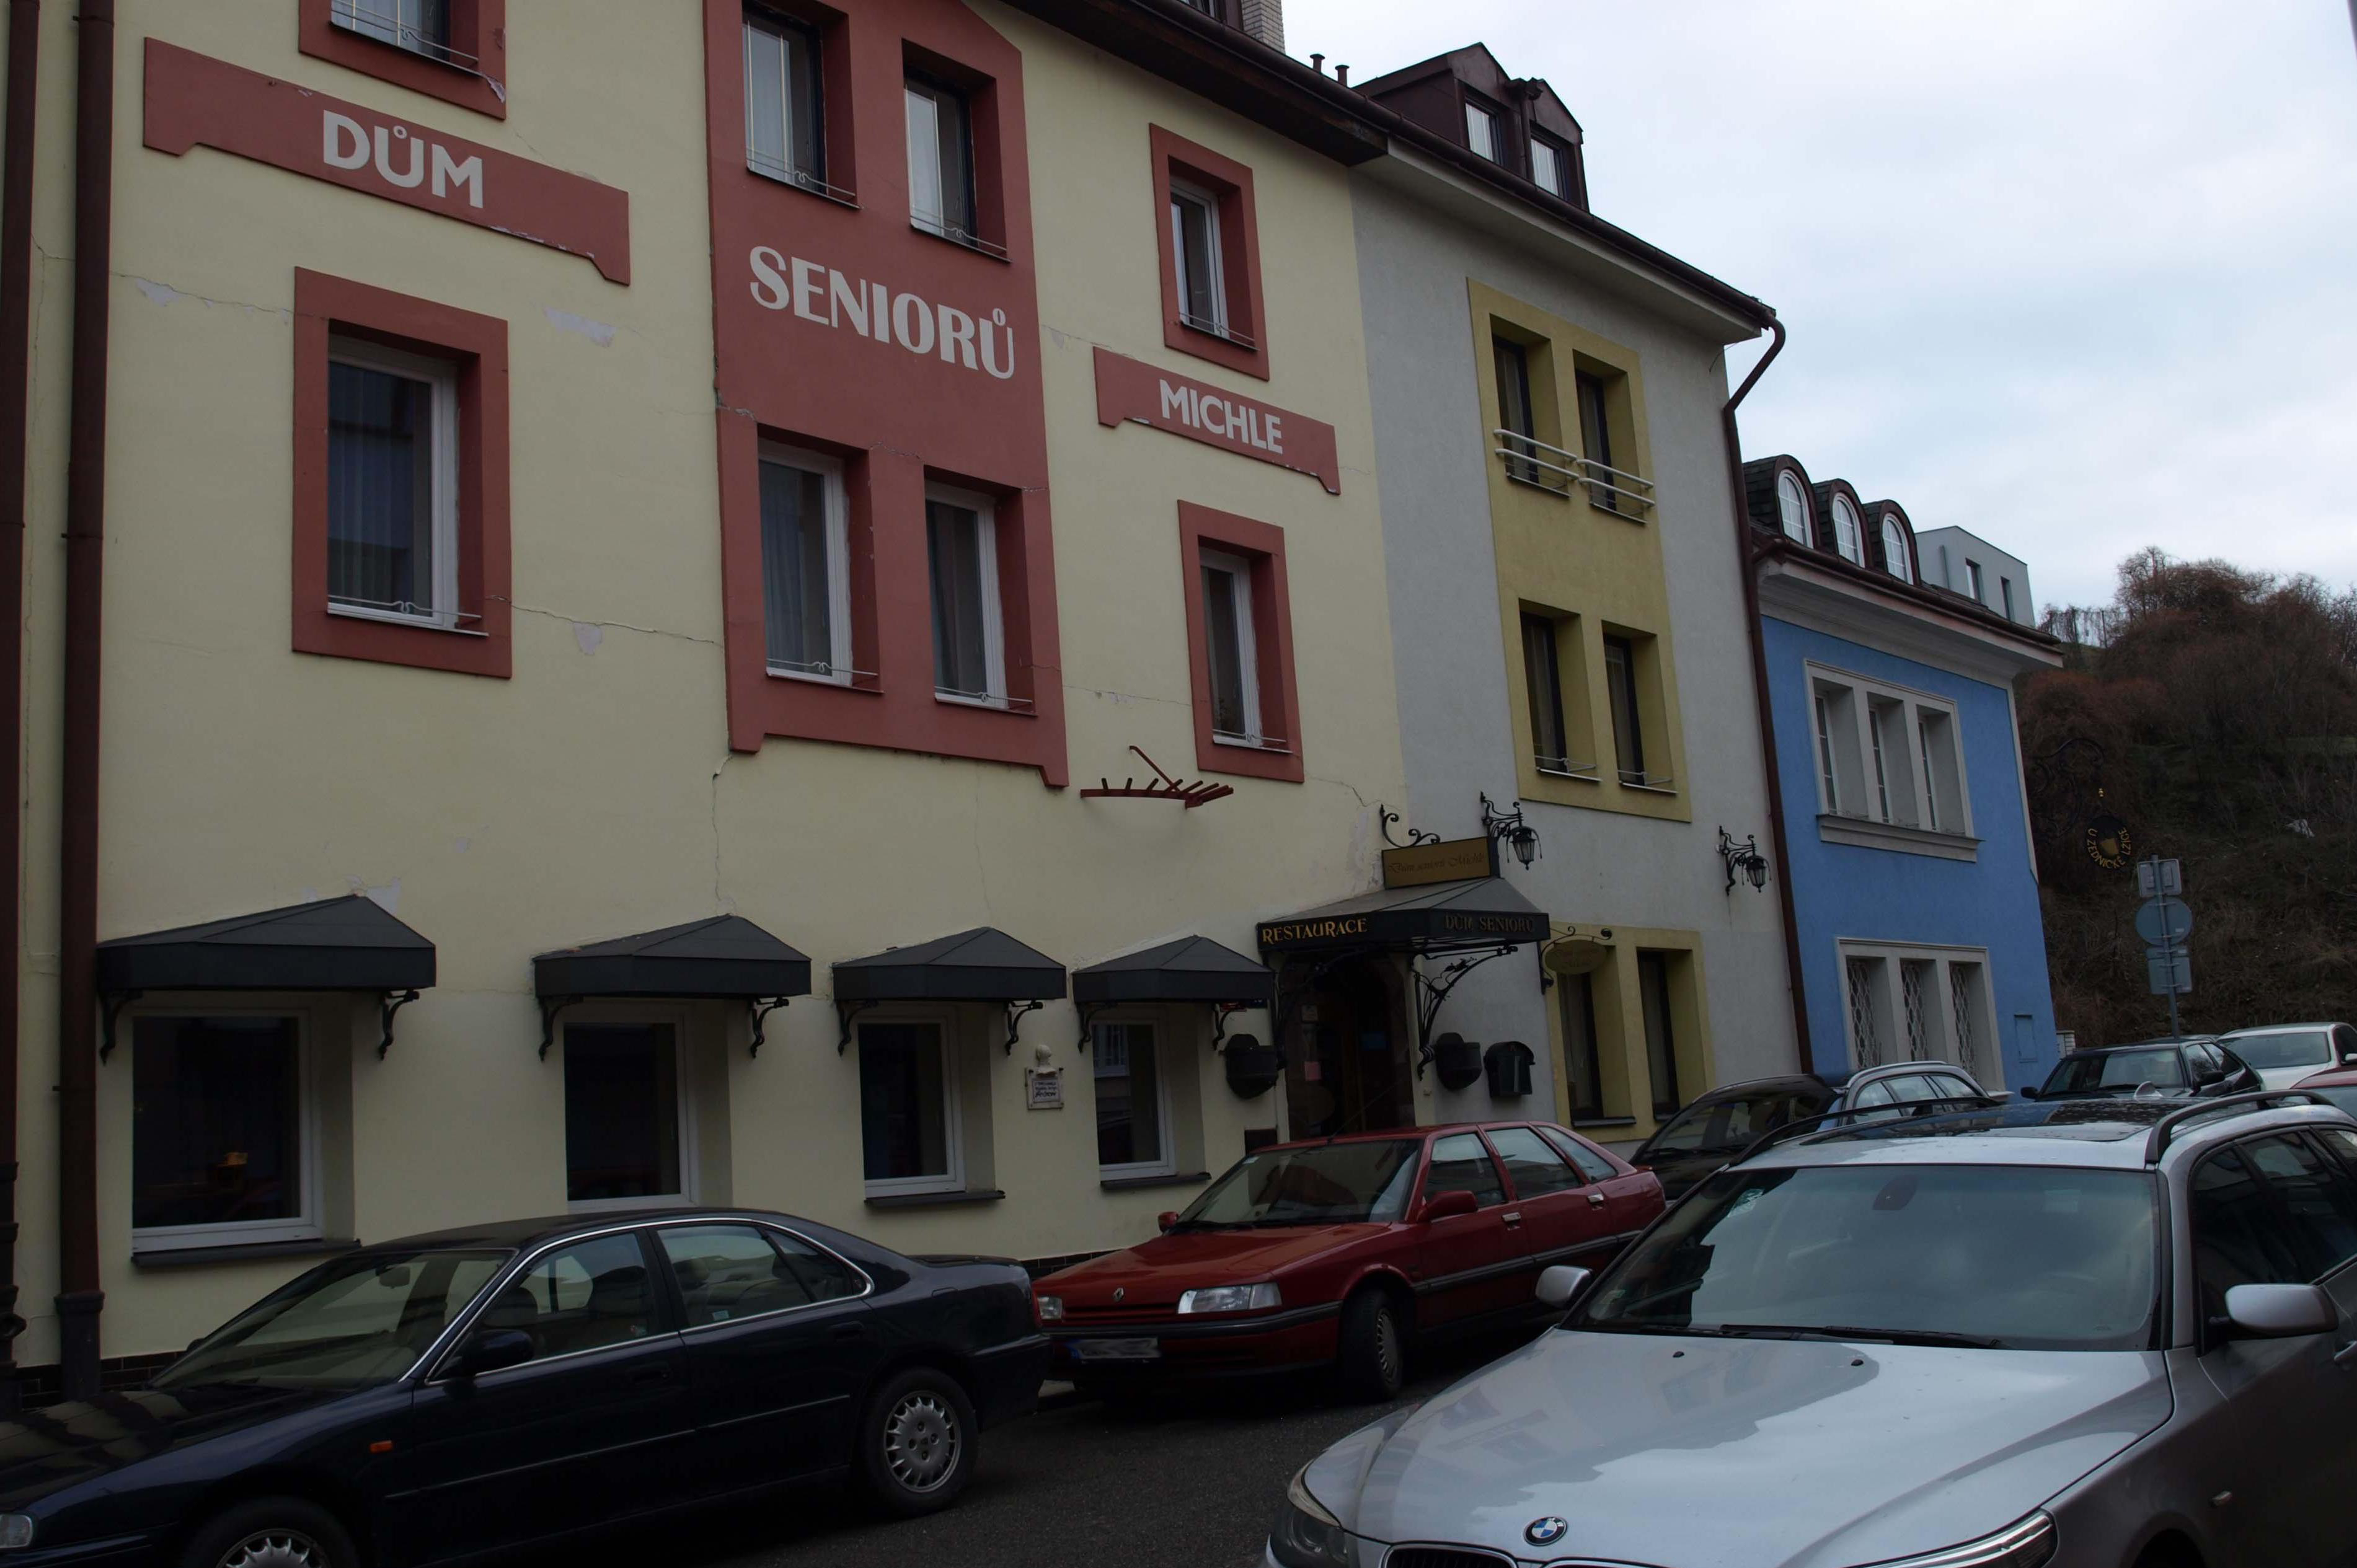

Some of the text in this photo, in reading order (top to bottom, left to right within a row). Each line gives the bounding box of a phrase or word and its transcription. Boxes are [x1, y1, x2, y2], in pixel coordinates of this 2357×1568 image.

[323, 110, 484, 209] DŮM
[750, 245, 1015, 379] SENIORŮ
[1159, 379, 1283, 455] MICHLE
[1262, 918, 1368, 945] RESTAURACE
